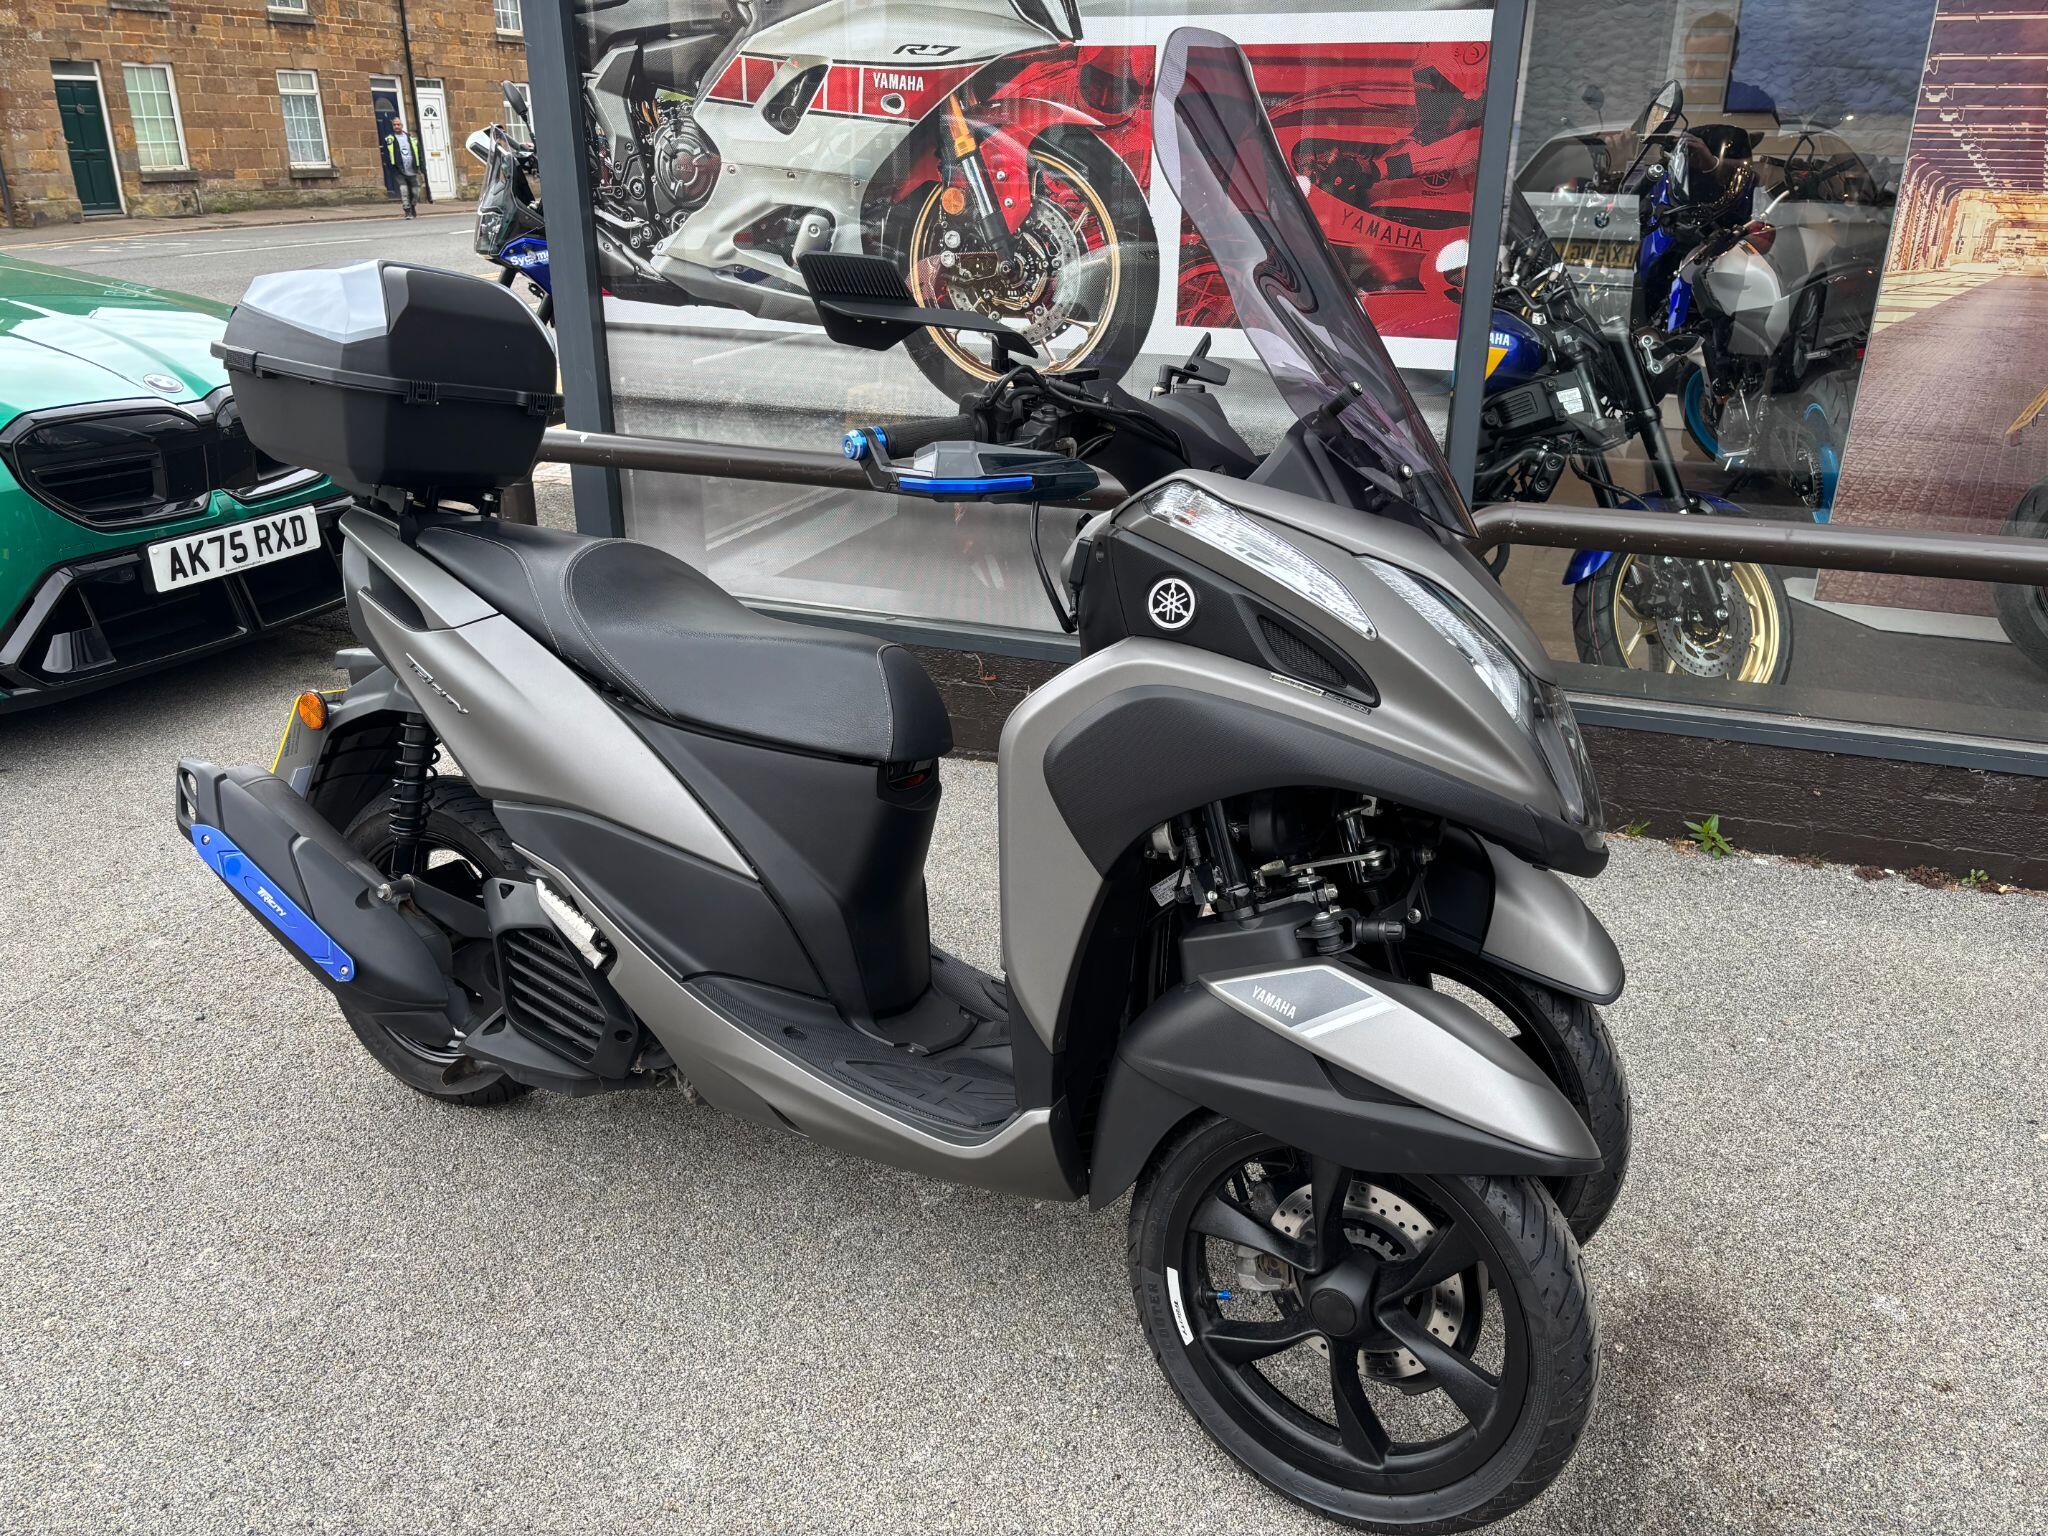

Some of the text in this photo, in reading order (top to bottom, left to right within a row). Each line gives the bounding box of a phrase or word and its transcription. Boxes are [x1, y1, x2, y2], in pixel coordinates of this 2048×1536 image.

[873, 72, 924, 92] YAMAHA
[1340, 208, 1424, 249] YAMAHA
[170, 514, 307, 582] AK75 RXD
[1252, 984, 1297, 1020] YAMAHA
